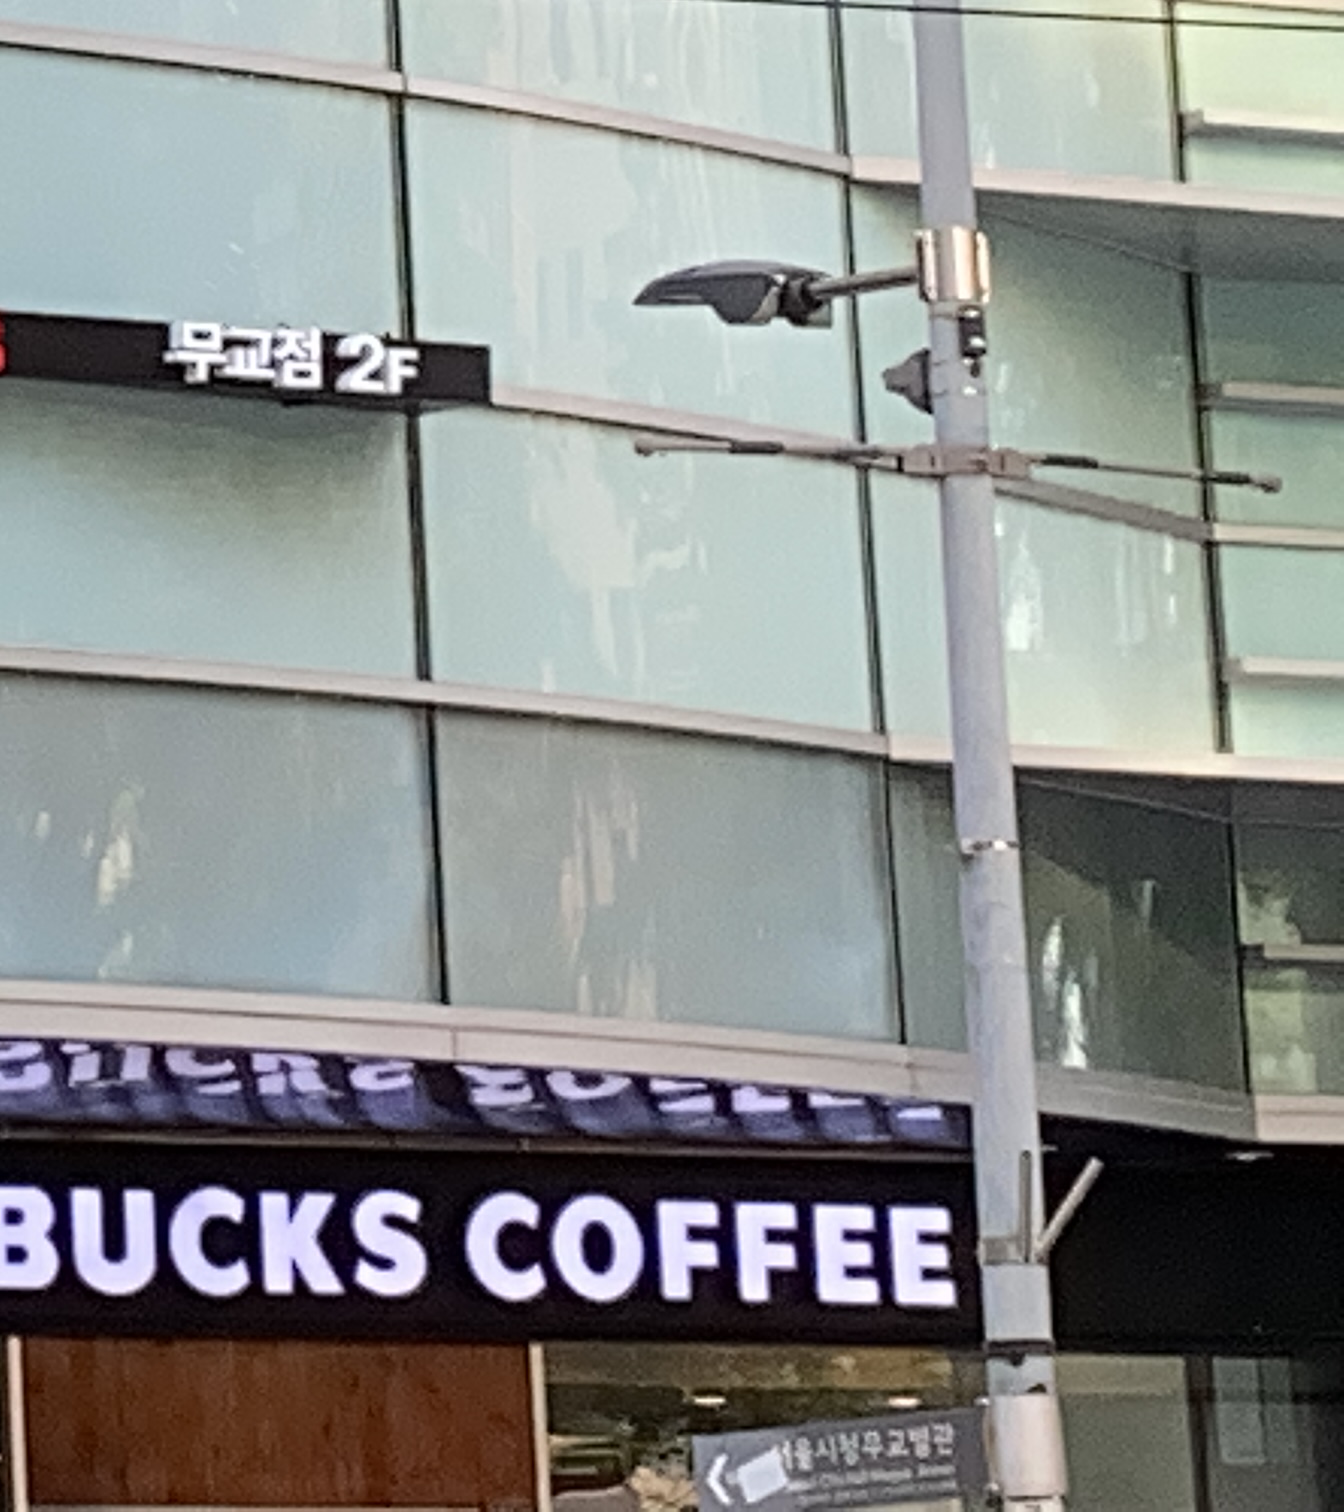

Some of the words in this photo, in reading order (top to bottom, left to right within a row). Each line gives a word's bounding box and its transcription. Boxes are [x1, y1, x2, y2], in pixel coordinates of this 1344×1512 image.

[163, 321, 322, 390] 무교점
[334, 333, 419, 395] 2F
[463, 1190, 958, 1308] COFFEE
